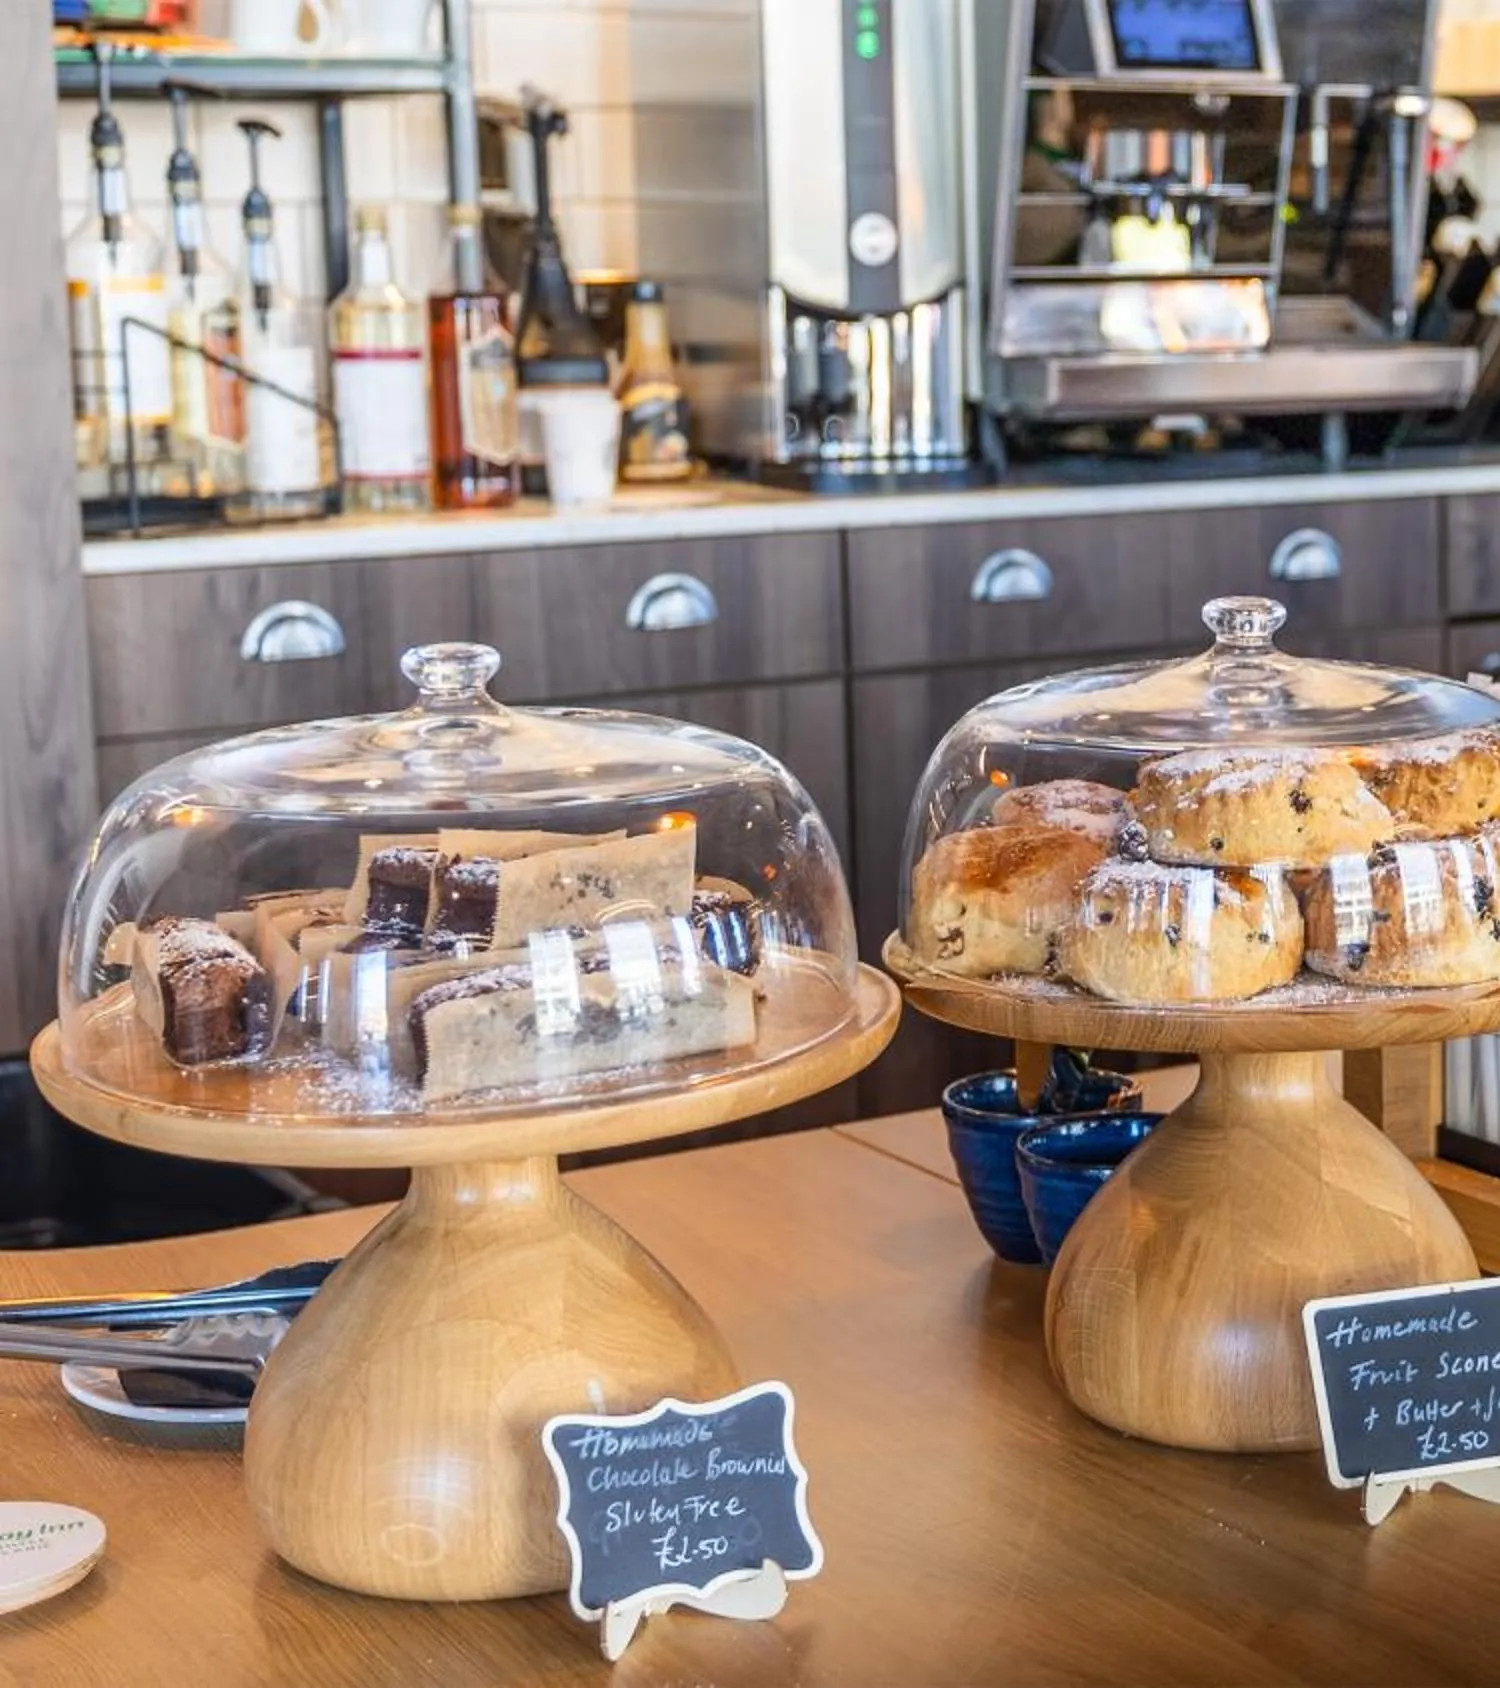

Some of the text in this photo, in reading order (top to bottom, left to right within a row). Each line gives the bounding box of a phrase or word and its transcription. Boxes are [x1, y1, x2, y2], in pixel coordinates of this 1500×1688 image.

[1326, 1307, 1479, 1348] Homemade
[1350, 1359, 1419, 1391] Fruit
[1396, 1400, 1464, 1426] Butter
[1417, 1425, 1489, 1460] £2.50
[587, 1455, 699, 1492] Chocolate
